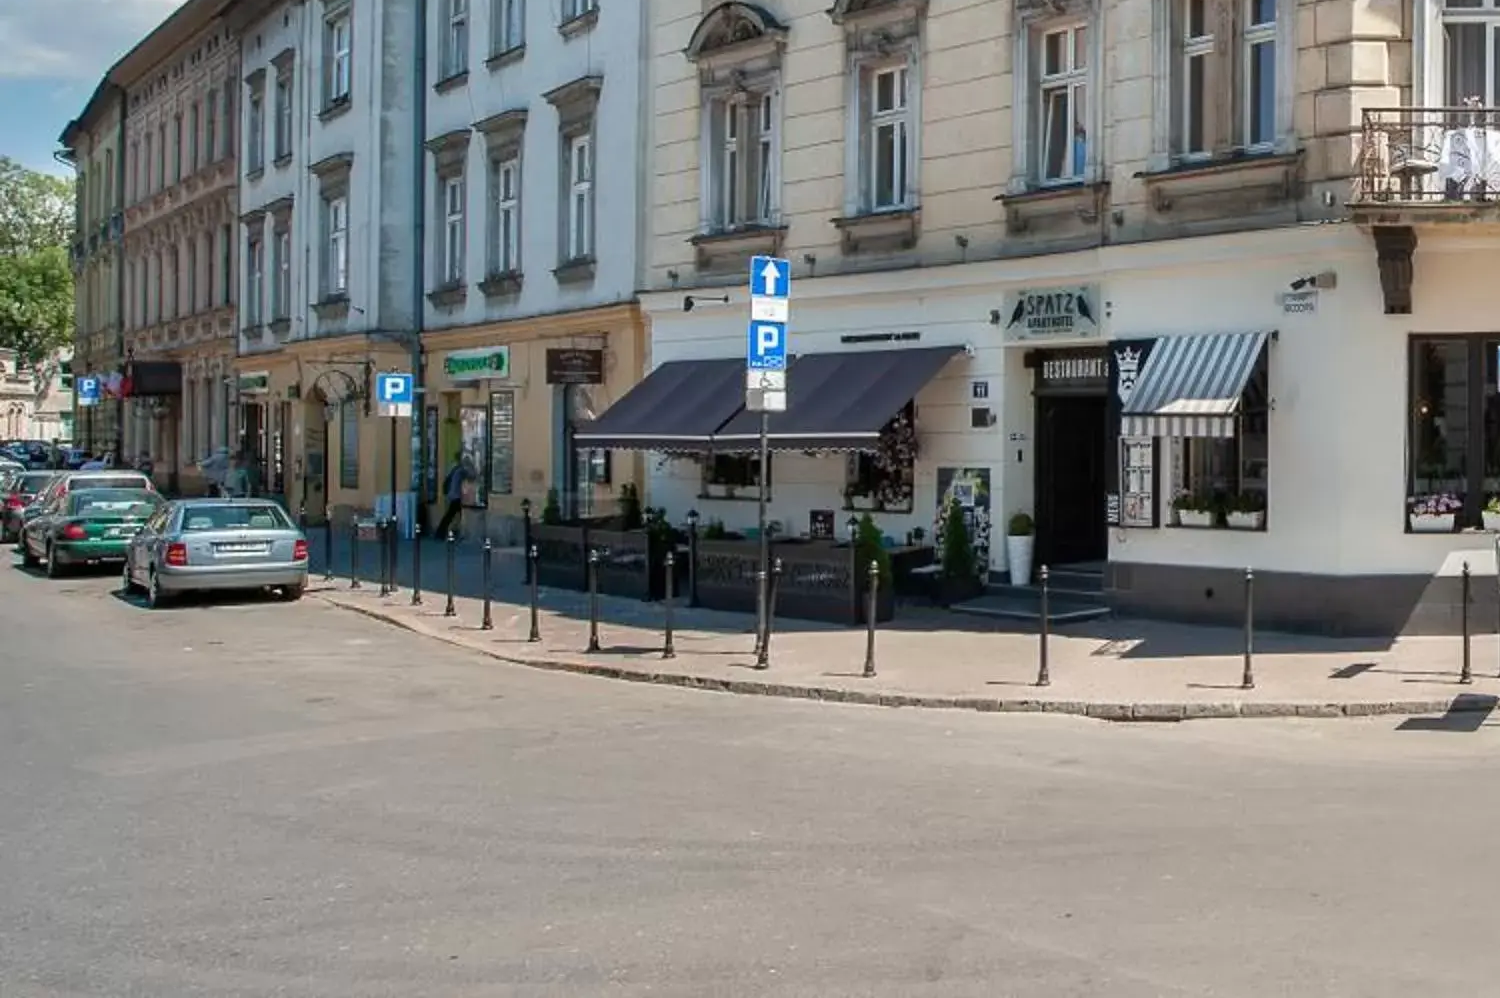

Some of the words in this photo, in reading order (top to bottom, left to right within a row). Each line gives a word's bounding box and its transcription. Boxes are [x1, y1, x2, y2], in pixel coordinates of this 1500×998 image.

[1027, 293, 1073, 315] SPATZ
[757, 325, 779, 356] P
[1043, 359, 1102, 378] RESTAURANT
[385, 377, 405, 399] P
